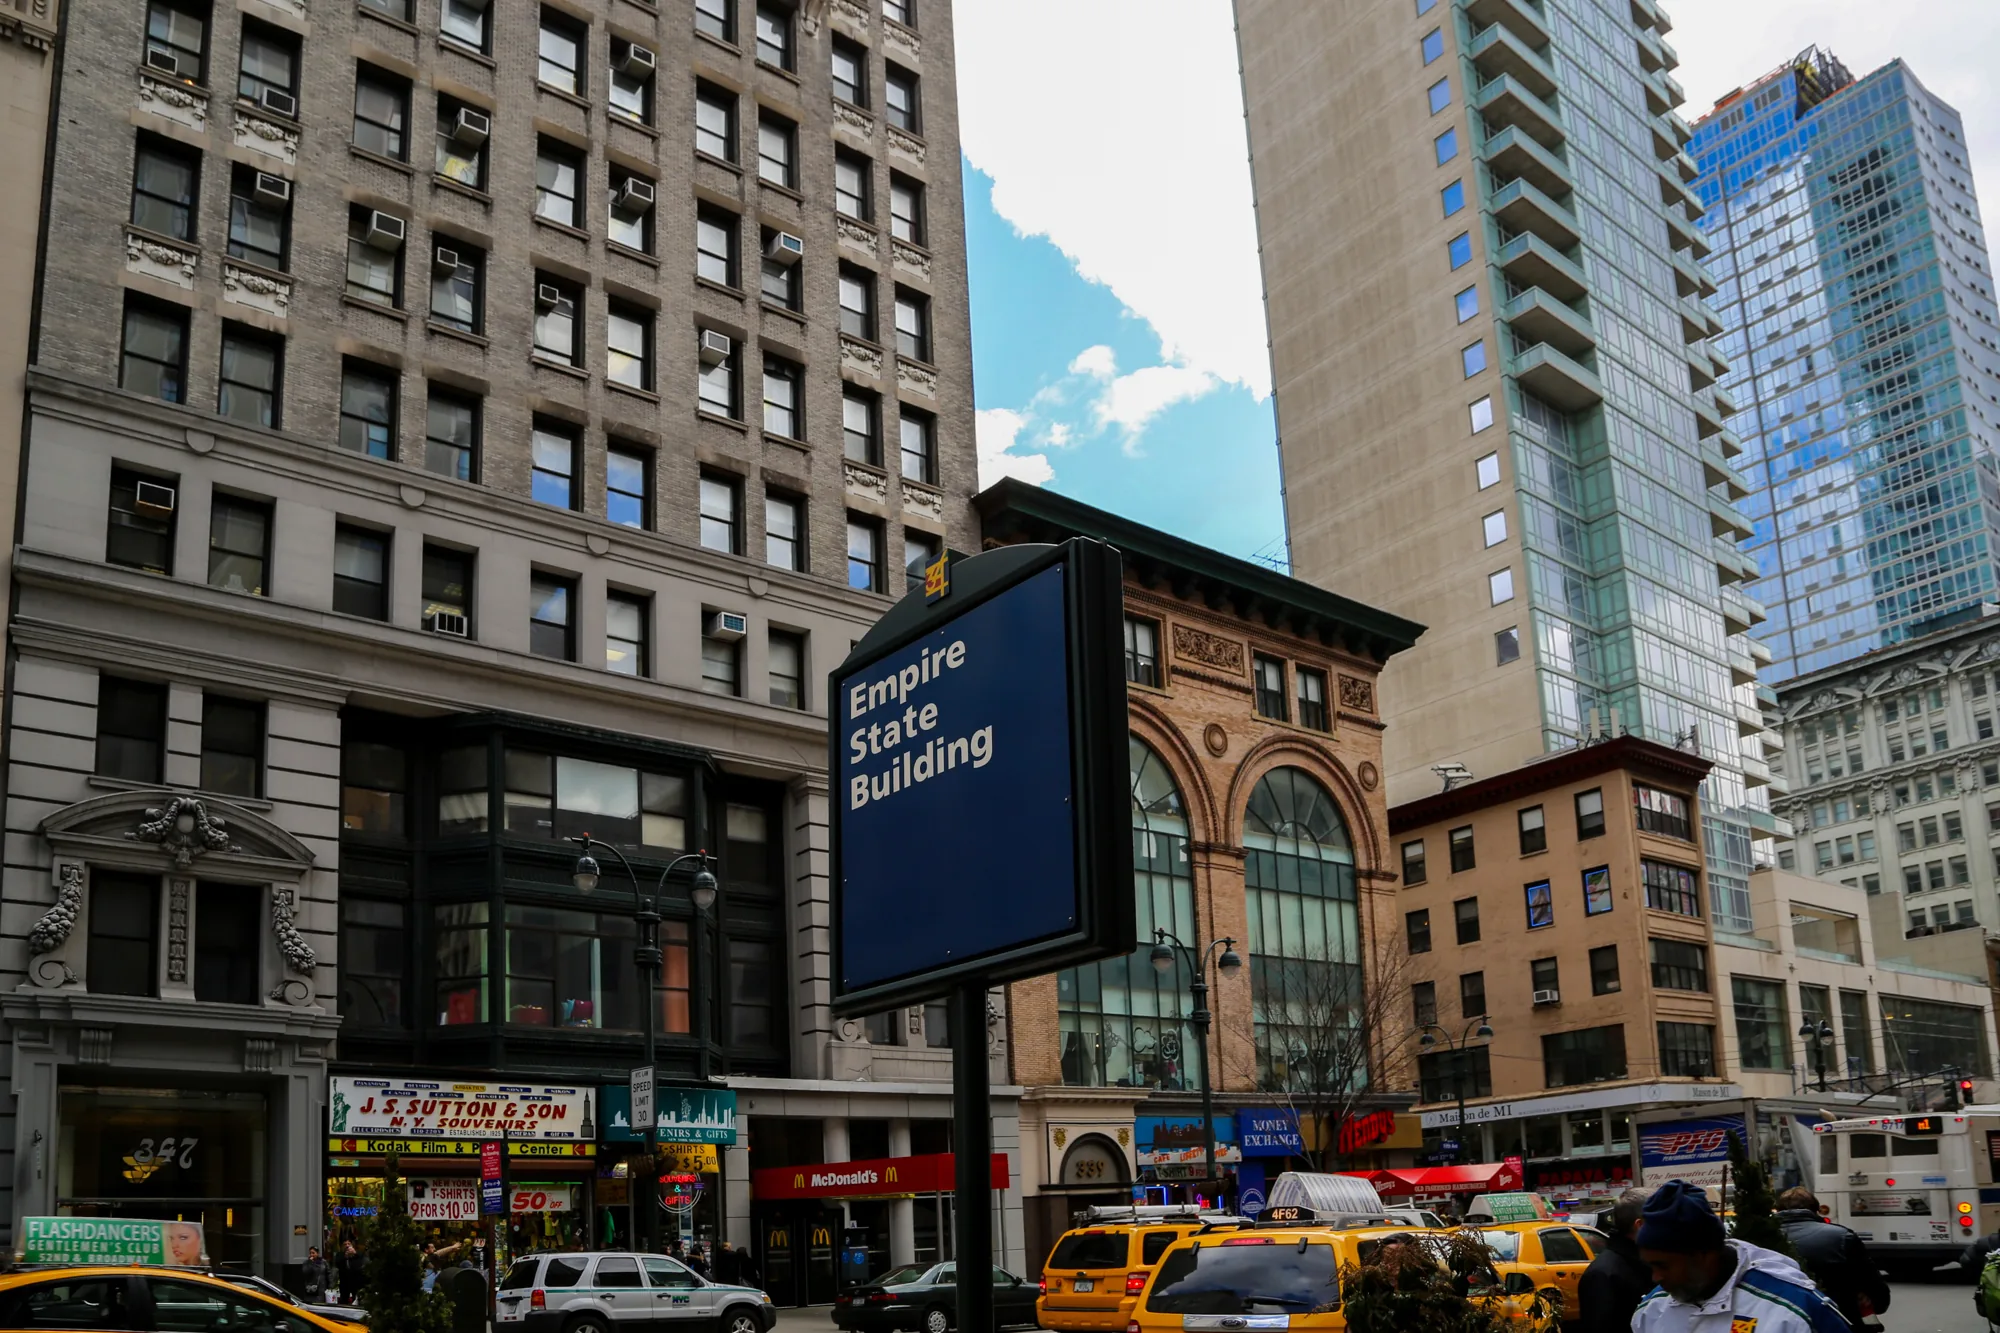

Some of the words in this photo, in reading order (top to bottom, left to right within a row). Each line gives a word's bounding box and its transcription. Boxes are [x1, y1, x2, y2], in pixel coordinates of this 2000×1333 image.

[851, 640, 966, 719] Empire
[851, 702, 938, 764] State
[851, 725, 993, 810] Building
[632, 1081, 651, 1093] SPEED
[1712, 1088, 1719, 1096] de
[1720, 1087, 1730, 1097] MI
[635, 1096, 649, 1107] LIMIT
[406, 1099, 497, 1117] SUTTON
[503, 1103, 517, 1117] &
[524, 1104, 567, 1119] SON
[1478, 1108, 1490, 1119] de
[1493, 1105, 1512, 1117] MI
[638, 1110, 647, 1122] 30
[437, 1118, 538, 1130] SOUVENIRS
[1252, 1119, 1289, 1131] MONEY
[1882, 1122, 1904, 1130] 6717
[695, 1130, 702, 1138] &
[706, 1130, 728, 1138] GIFTS
[1244, 1134, 1300, 1147] EXCHANGE
[1669, 1129, 1726, 1155] PFG
[367, 1140, 411, 1152] Kodak
[421, 1141, 447, 1152] Film
[455, 1142, 464, 1153] &
[520, 1144, 563, 1154] Center
[134, 1138, 198, 1169] 347
[1076, 1160, 1104, 1178] 339
[1665, 1170, 1705, 1178] Innovative
[433, 1179, 450, 1187] NEW
[451, 1179, 472, 1187] YORK
[659, 1174, 696, 1183] SOUVENIRS
[811, 1170, 878, 1187] McDonald's
[431, 1188, 475, 1199] T-SHIRTS
[550, 1201, 563, 1209] OFF
[665, 1196, 690, 1205] GIFTS
[333, 1206, 378, 1217] CAMERAS
[410, 1202, 419, 1217] 9
[420, 1203, 437, 1217] FOR
[1272, 1208, 1298, 1220] 4F62
[29, 1221, 160, 1241] FLASHDANCERS
[28, 1240, 121, 1253] GENTLEMEN'S
[127, 1242, 160, 1254] CLUB
[38, 1253, 69, 1262] 52ND
[72, 1254, 82, 1262] &
[88, 1254, 149, 1263] BROADWAY
